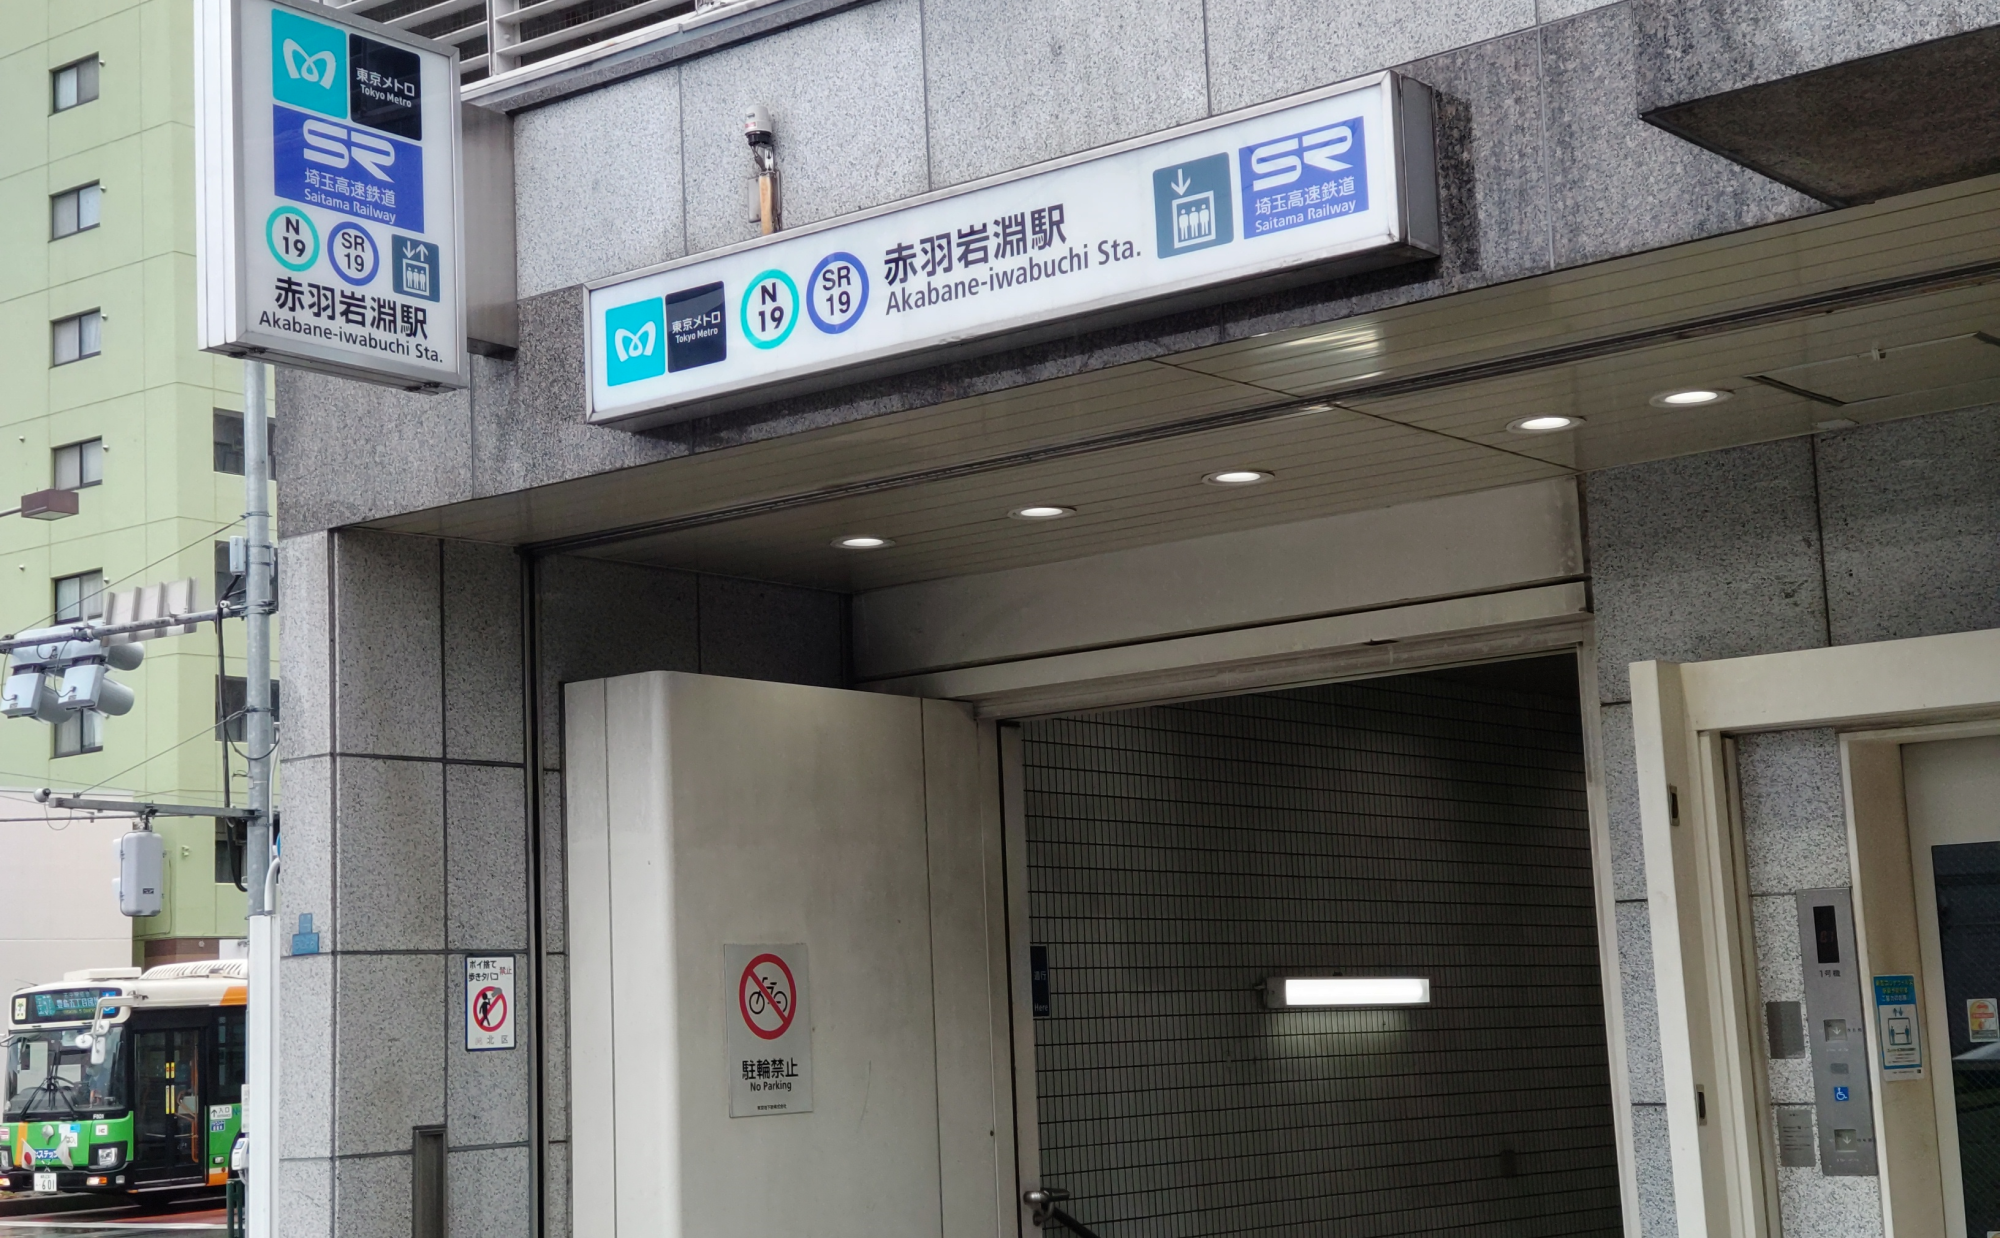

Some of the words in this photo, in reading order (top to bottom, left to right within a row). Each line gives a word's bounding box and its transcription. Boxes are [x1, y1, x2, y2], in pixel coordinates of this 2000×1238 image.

[356, 67, 415, 97] 東京メトロ
[360, 84, 385, 100] Tokyo
[386, 91, 412, 108] Metro
[303, 118, 395, 183] SR
[1251, 125, 1354, 192] SR
[305, 167, 397, 208] 埼玉高速鉄道
[1255, 176, 1356, 216] 埼玉高速鉄道
[304, 189, 350, 211] Saitama
[353, 202, 397, 224] Railway
[1255, 212, 1304, 233] Saitama
[1308, 199, 1356, 221] Railway
[285, 216, 300, 236] N
[282, 236, 306, 258] 19
[341, 232, 365, 253] SR
[884, 203, 1067, 286] 赤羽岩淵駅
[344, 252, 365, 273] 19
[822, 265, 851, 291] SR
[885, 244, 1089, 316] Akabane-iwabuchi
[1097, 239, 1141, 265] Sta.
[760, 282, 777, 306] N
[825, 291, 851, 316] 19
[275, 276, 428, 340] 赤羽岩淵駅
[758, 305, 785, 332] 19
[672, 311, 721, 334] 東京メトロ
[675, 332, 696, 344] Tokyo
[697, 326, 719, 338] Metro
[259, 310, 410, 356] Akabane-iwabuchi
[415, 343, 443, 363] Sta.
[468, 972, 499, 982] 歩きタバコ
[469, 960, 497, 969] ポイ捨て
[499, 966, 512, 975] 禁止
[742, 1057, 799, 1080] 駐輪禁止
[750, 1081, 761, 1092] No
[763, 1080, 792, 1092] Parking
